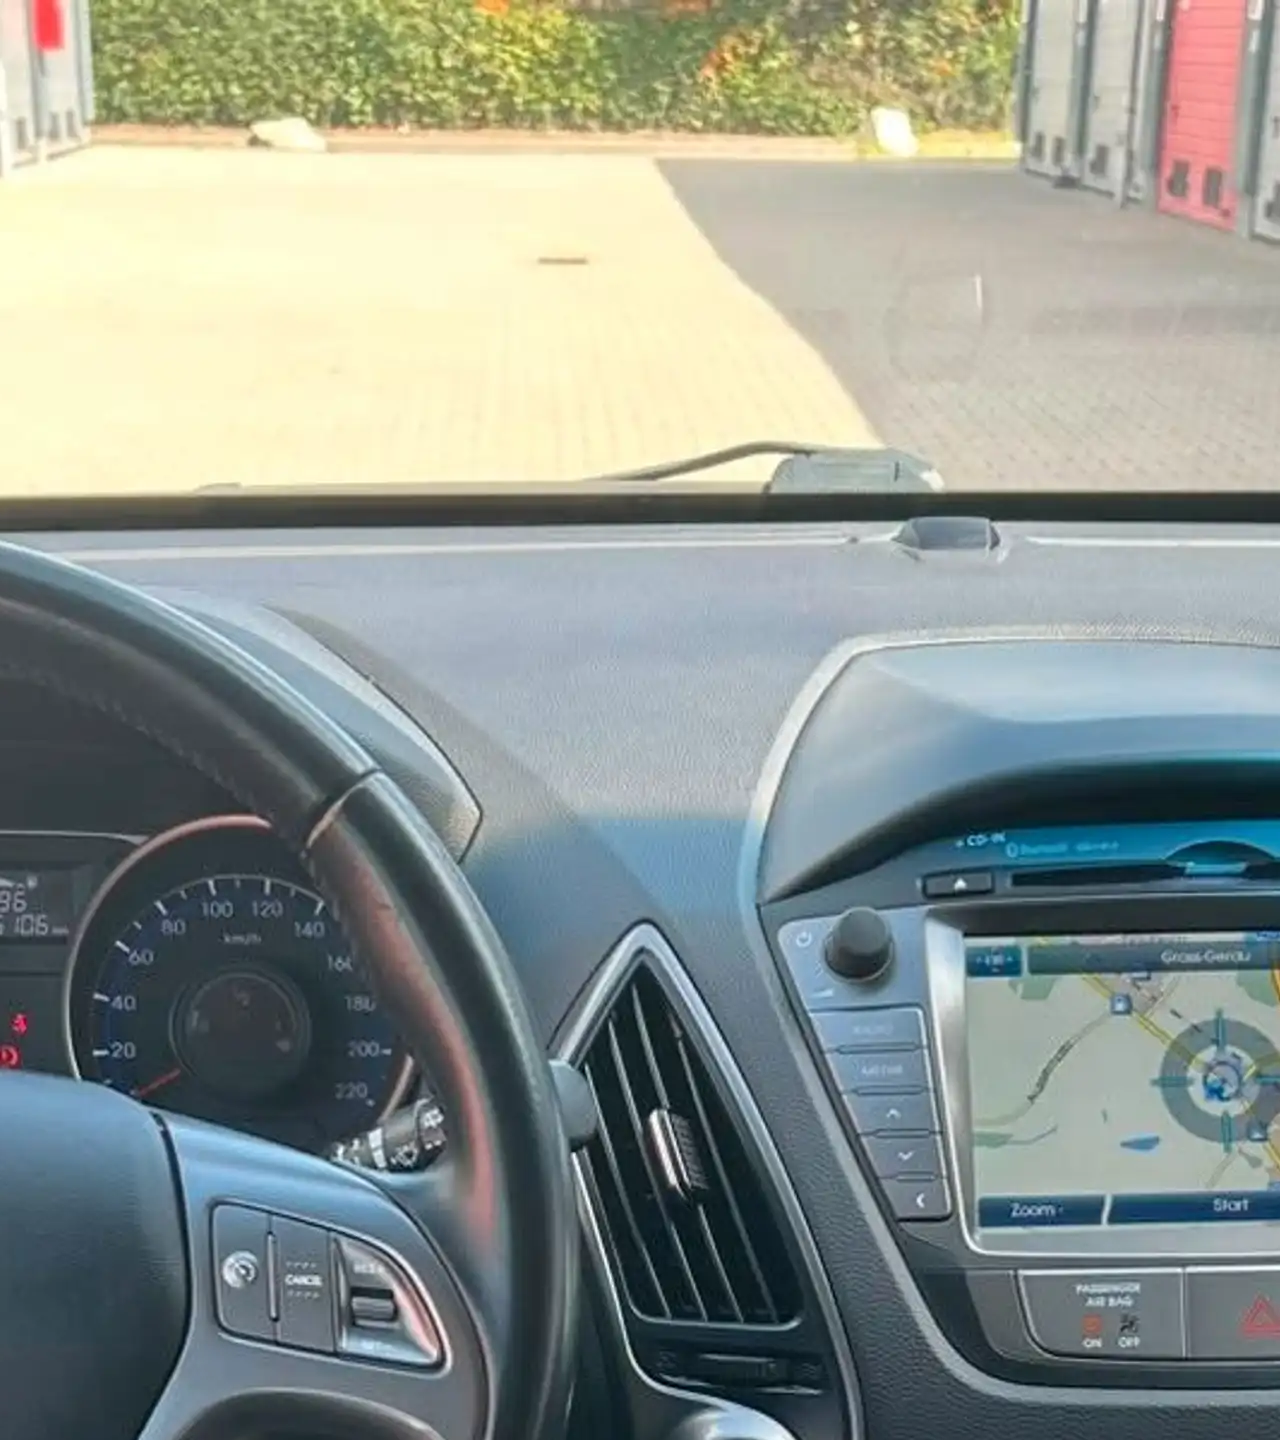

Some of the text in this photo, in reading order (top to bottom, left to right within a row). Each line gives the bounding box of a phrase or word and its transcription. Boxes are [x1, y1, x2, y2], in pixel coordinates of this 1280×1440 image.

[201, 902, 233, 917] 100
[251, 901, 284, 917] 120
[161, 919, 186, 935] 80
[294, 920, 326, 938] 140
[129, 950, 153, 965] 60
[110, 996, 136, 1011] 40
[110, 1043, 136, 1058] 20
[349, 1043, 380, 1058] 200
[334, 1081, 368, 1099] 220
[1010, 1202, 1056, 1218] Zoom
[1213, 1197, 1249, 1213] Start
